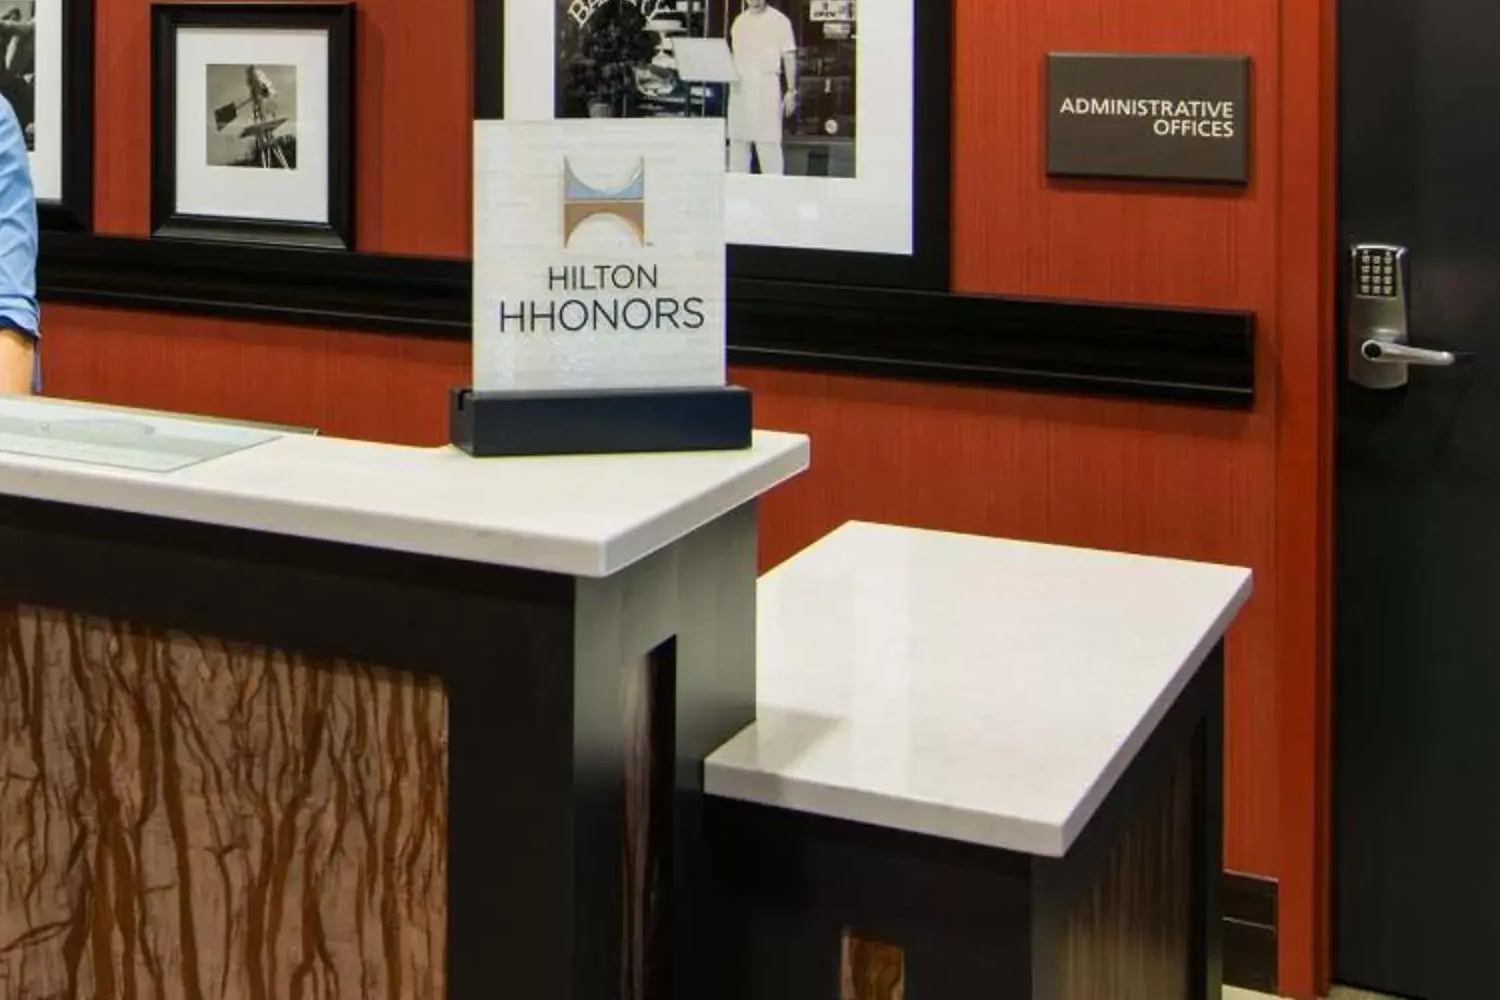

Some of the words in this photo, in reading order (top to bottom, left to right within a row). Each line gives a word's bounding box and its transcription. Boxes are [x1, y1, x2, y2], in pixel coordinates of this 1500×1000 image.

[1059, 97, 1235, 119] ADMINISTRATIVE
[1153, 118, 1235, 138] OFFICES
[548, 263, 658, 291] HILTON
[499, 297, 706, 333] HHONORS
